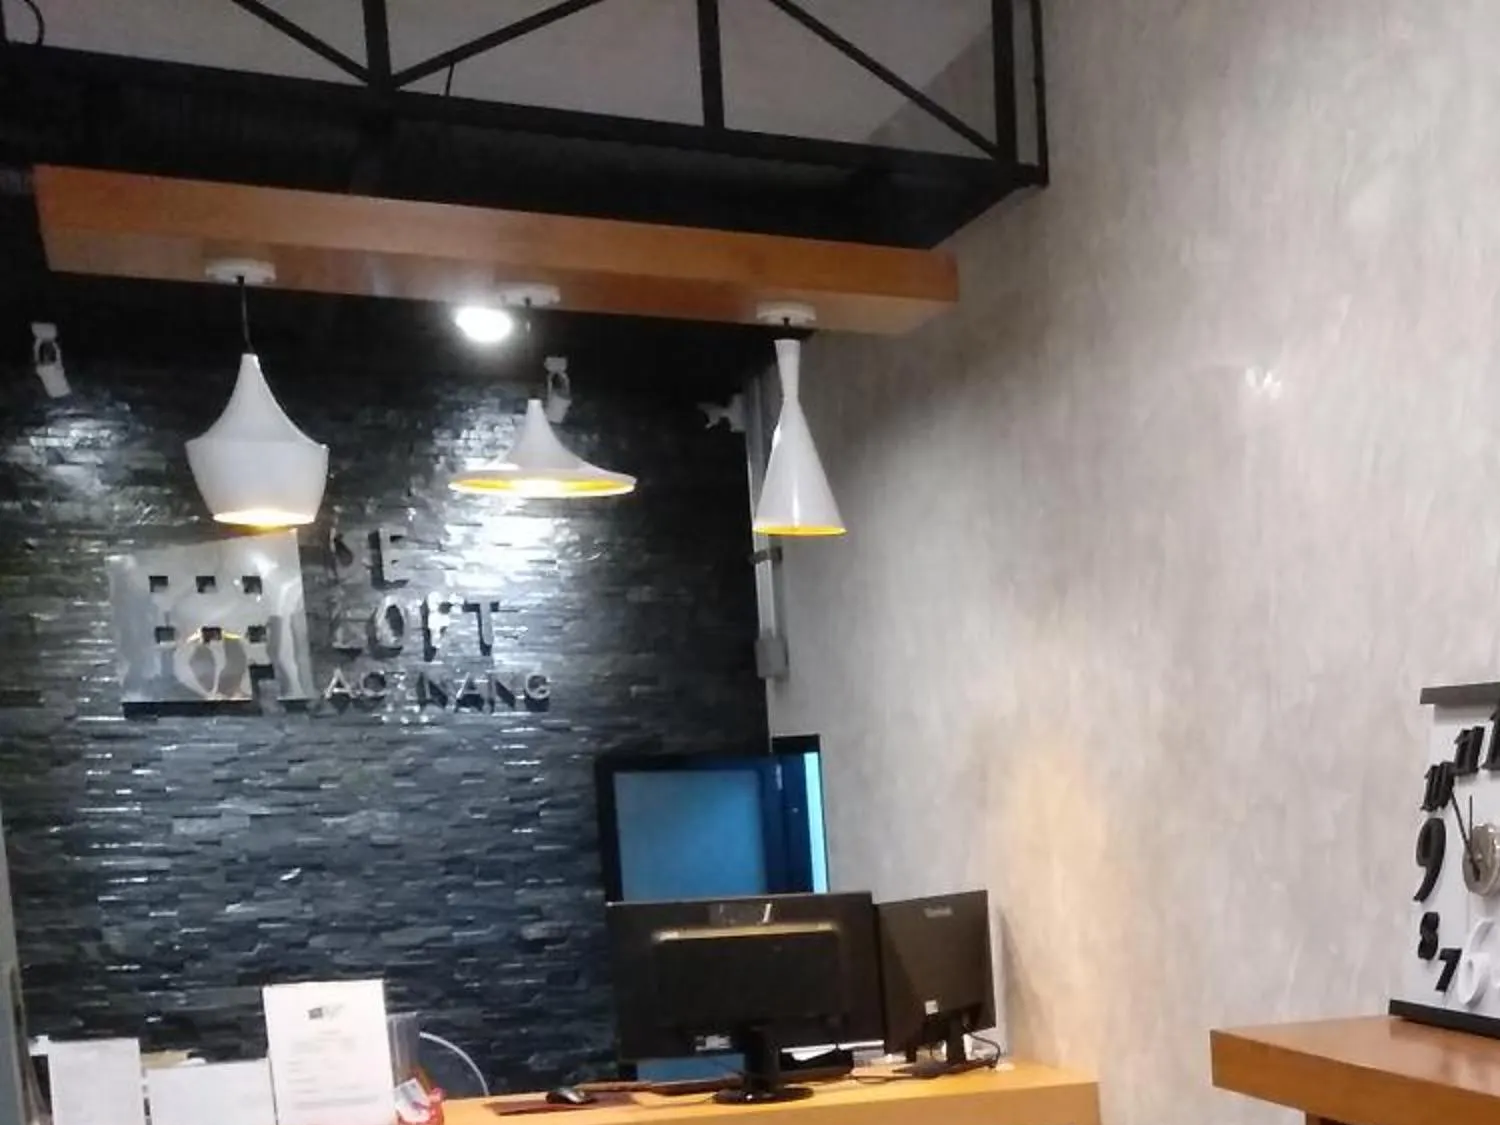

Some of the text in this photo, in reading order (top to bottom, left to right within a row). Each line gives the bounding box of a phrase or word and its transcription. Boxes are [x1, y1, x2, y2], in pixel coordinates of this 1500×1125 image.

[1413, 818, 1446, 902] 9
[1417, 912, 1440, 960] 8
[1435, 948, 1462, 992] 7
